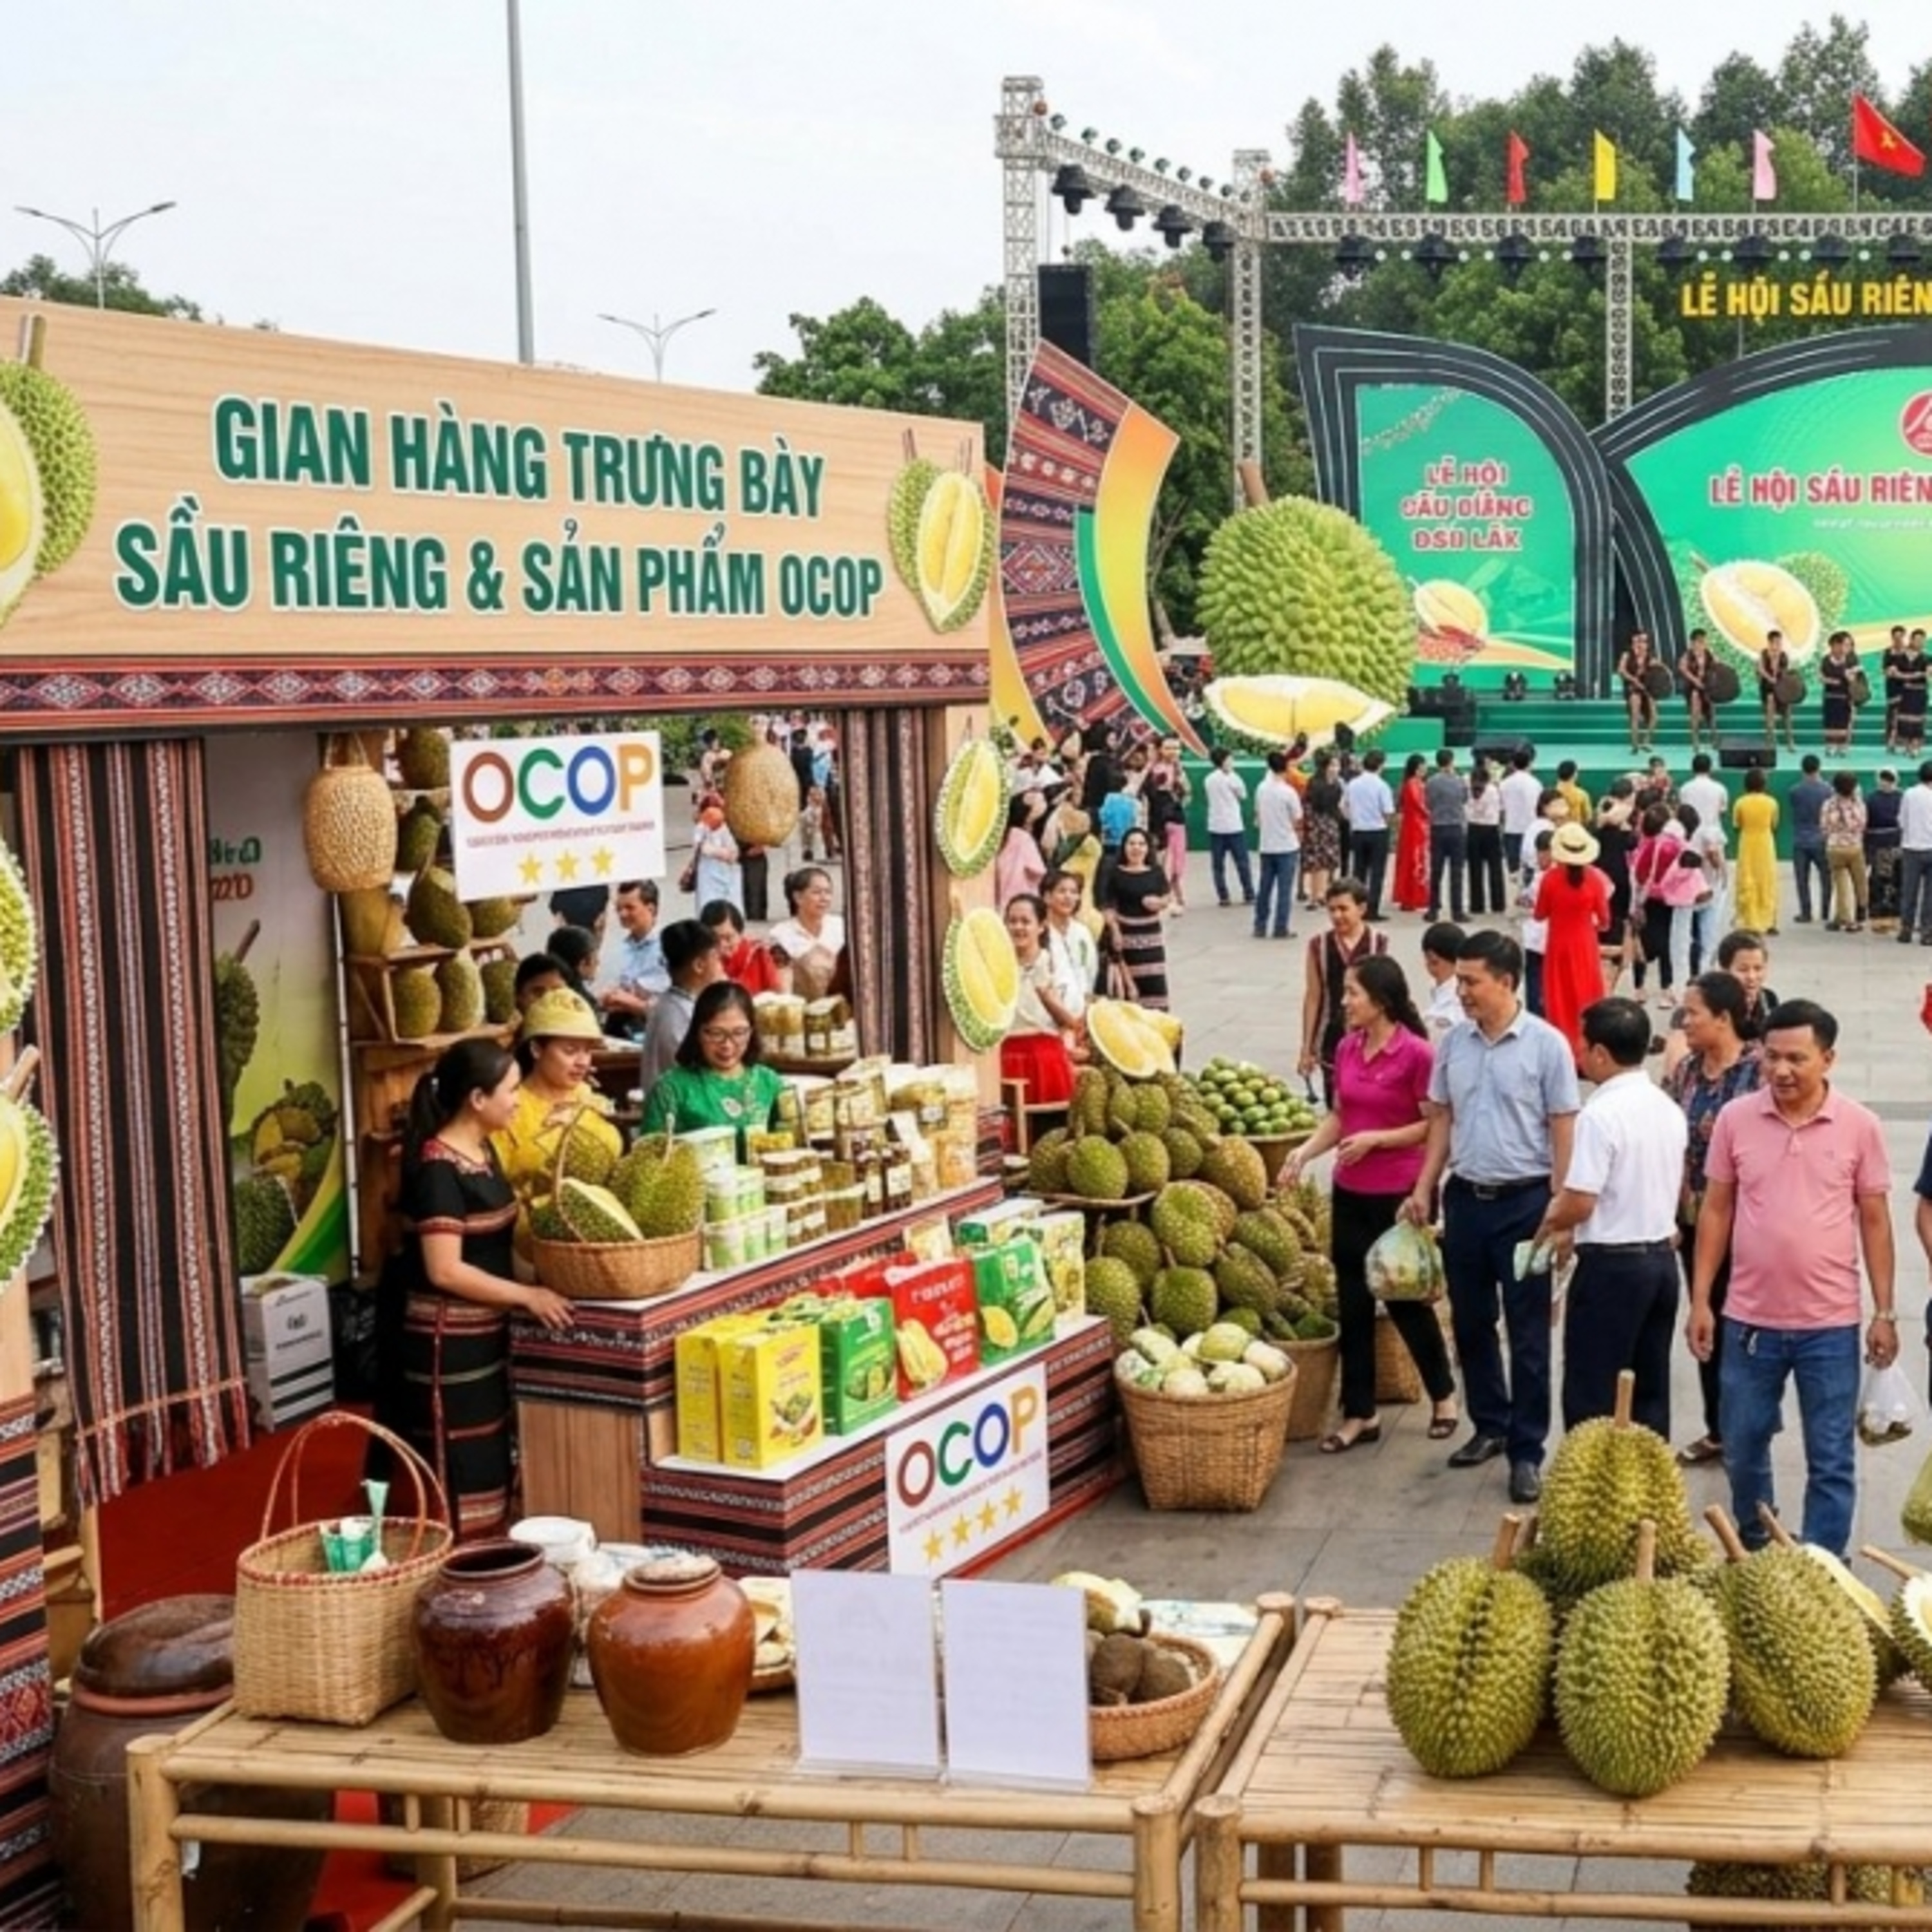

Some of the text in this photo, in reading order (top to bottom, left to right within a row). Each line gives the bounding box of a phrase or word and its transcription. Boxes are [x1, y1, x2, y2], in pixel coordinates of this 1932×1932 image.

[215, 397, 824, 518] GIAN HÀNG TRƯNG BÀY
[117, 494, 883, 616] SẦU RIÊNG & SẢN PHẨM OCOP
[463, 743, 654, 823] OCOP
[897, 1385, 1039, 1508] OCOP
